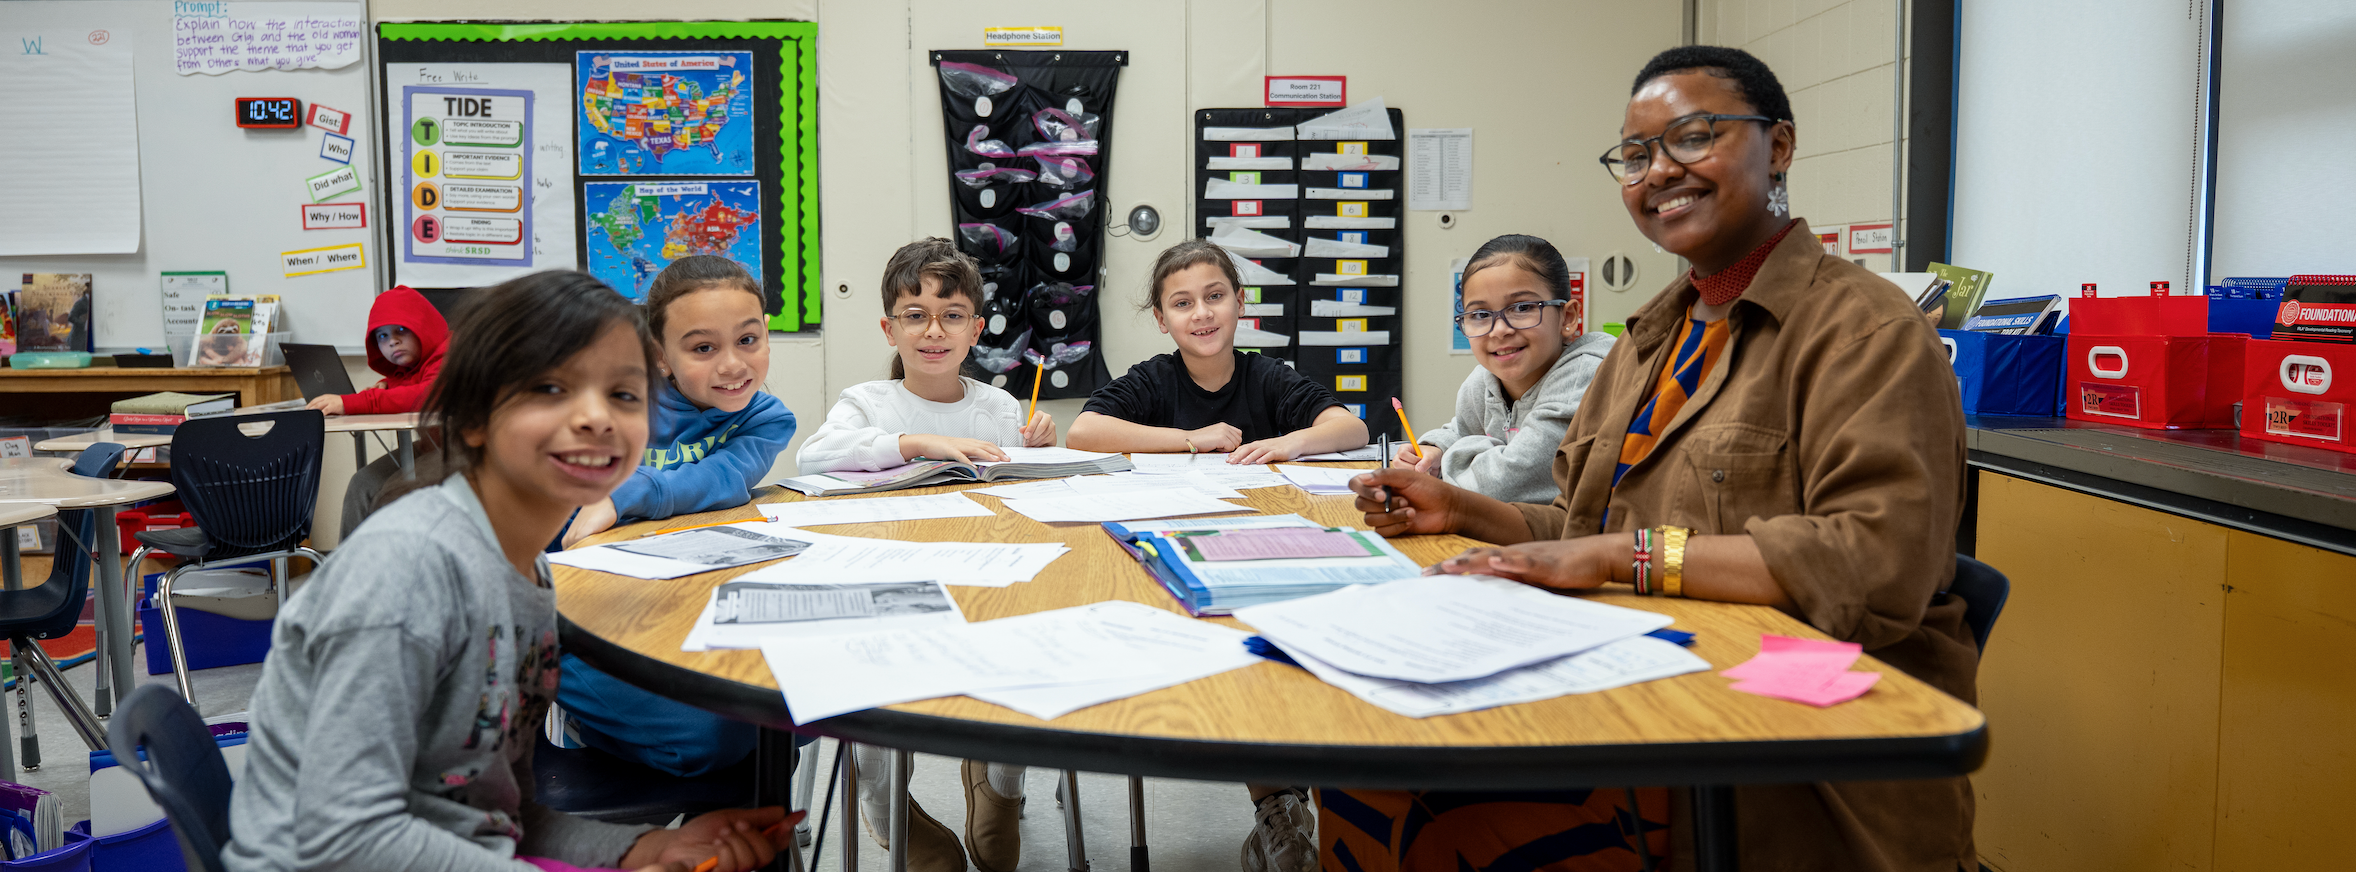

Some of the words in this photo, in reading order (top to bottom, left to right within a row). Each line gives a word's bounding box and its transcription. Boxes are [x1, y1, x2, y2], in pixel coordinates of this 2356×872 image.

[175, 0, 228, 16] Prompt:
[176, 17, 220, 34] Explain
[228, 17, 256, 30] how
[266, 20, 286, 31] the
[294, 15, 356, 30] interaction
[177, 33, 224, 46] between
[261, 31, 282, 42] and
[287, 31, 306, 41] the
[312, 29, 329, 40] old
[987, 33, 1031, 41] Headphone
[22, 35, 42, 54] W
[177, 45, 214, 59] support
[220, 44, 239, 55] the
[247, 43, 280, 55] theme
[286, 43, 308, 53] that
[315, 43, 332, 56] you
[337, 41, 354, 55] get
[176, 59, 201, 72] from
[247, 57, 269, 66] what
[275, 58, 291, 69] you
[614, 60, 640, 69] United
[643, 61, 667, 69] States
[670, 60, 678, 68] of
[681, 60, 715, 68] America
[419, 68, 443, 82] Free
[453, 71, 479, 82] Write
[444, 97, 492, 117] TIDE
[319, 114, 341, 128] Gist:
[421, 122, 434, 140] T
[650, 136, 672, 145] TEXAS
[328, 143, 349, 156] Who
[1350, 146, 1356, 155] 2
[424, 154, 430, 173] I
[314, 179, 329, 191] Did
[331, 172, 353, 185] what
[537, 178, 553, 189] help
[1242, 175, 1249, 185] 3
[421, 187, 436, 207] D
[639, 187, 654, 195] Map
[1349, 206, 1354, 214] 6
[310, 213, 330, 223] Why
[339, 212, 359, 220] How
[422, 220, 434, 239] E
[465, 247, 491, 255] SRSD
[287, 257, 314, 266] When
[327, 254, 357, 263] Where
[1347, 264, 1357, 272] 10
[1940, 269, 1949, 277] The
[1952, 276, 1974, 299] Jar
[1348, 292, 1358, 300] 12
[1975, 318, 2013, 328] FOUNDATIONAL
[2012, 316, 2034, 326] SKILLS
[1346, 352, 1355, 360] 16
[2087, 394, 2098, 405] 2R
[2273, 411, 2288, 424] 2R
[5, 442, 19, 450] Dog
